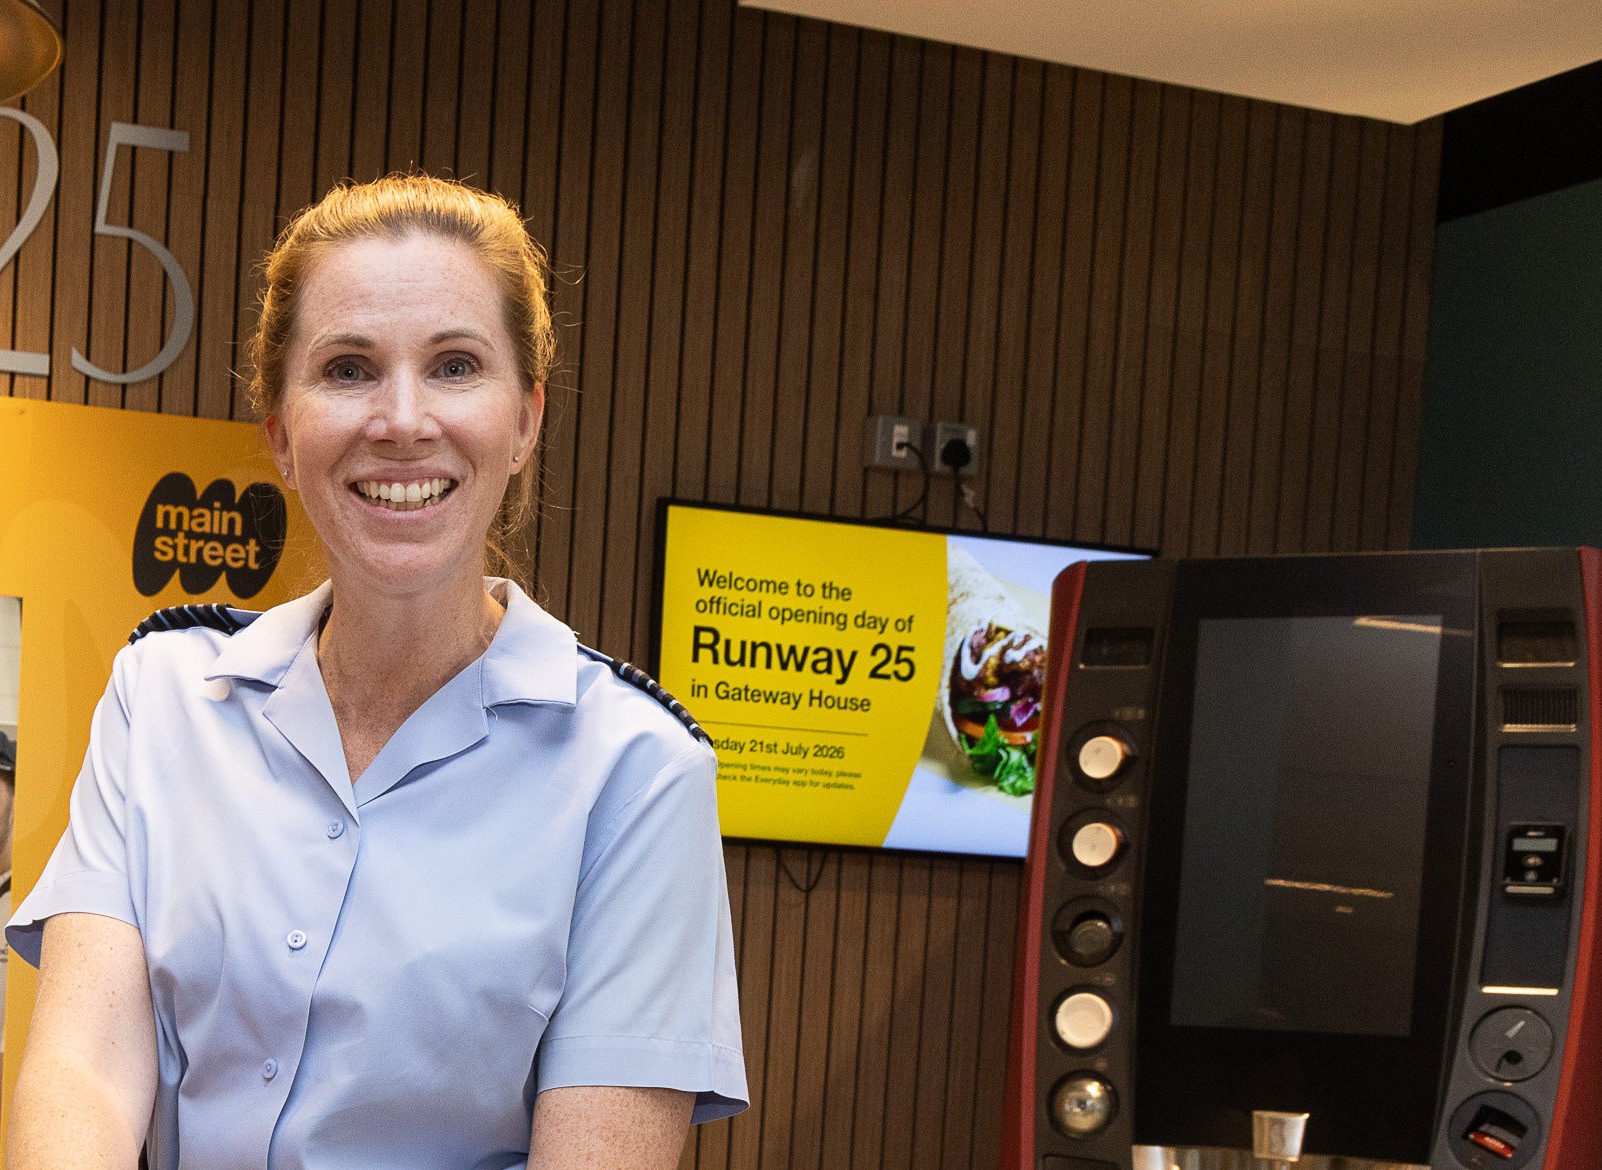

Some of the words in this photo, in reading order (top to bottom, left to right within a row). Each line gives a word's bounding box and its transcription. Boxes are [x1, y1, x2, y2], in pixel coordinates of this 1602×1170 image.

[155, 502, 242, 536] main
[153, 531, 261, 570] street
[697, 568, 789, 595] Welcome
[796, 579, 815, 598] to
[821, 581, 852, 601] the
[695, 595, 762, 619] official
[768, 605, 848, 631] opening
[853, 610, 889, 634] day
[894, 614, 914, 633] of
[692, 625, 858, 685] Runway
[868, 642, 916, 682] 25
[691, 679, 708, 698] in
[715, 681, 802, 710] Gateway
[809, 689, 871, 712] House
[713, 737, 746, 754] sday
[749, 739, 777, 754] 21st
[782, 742, 809, 759] July
[813, 744, 845, 759] 2026
